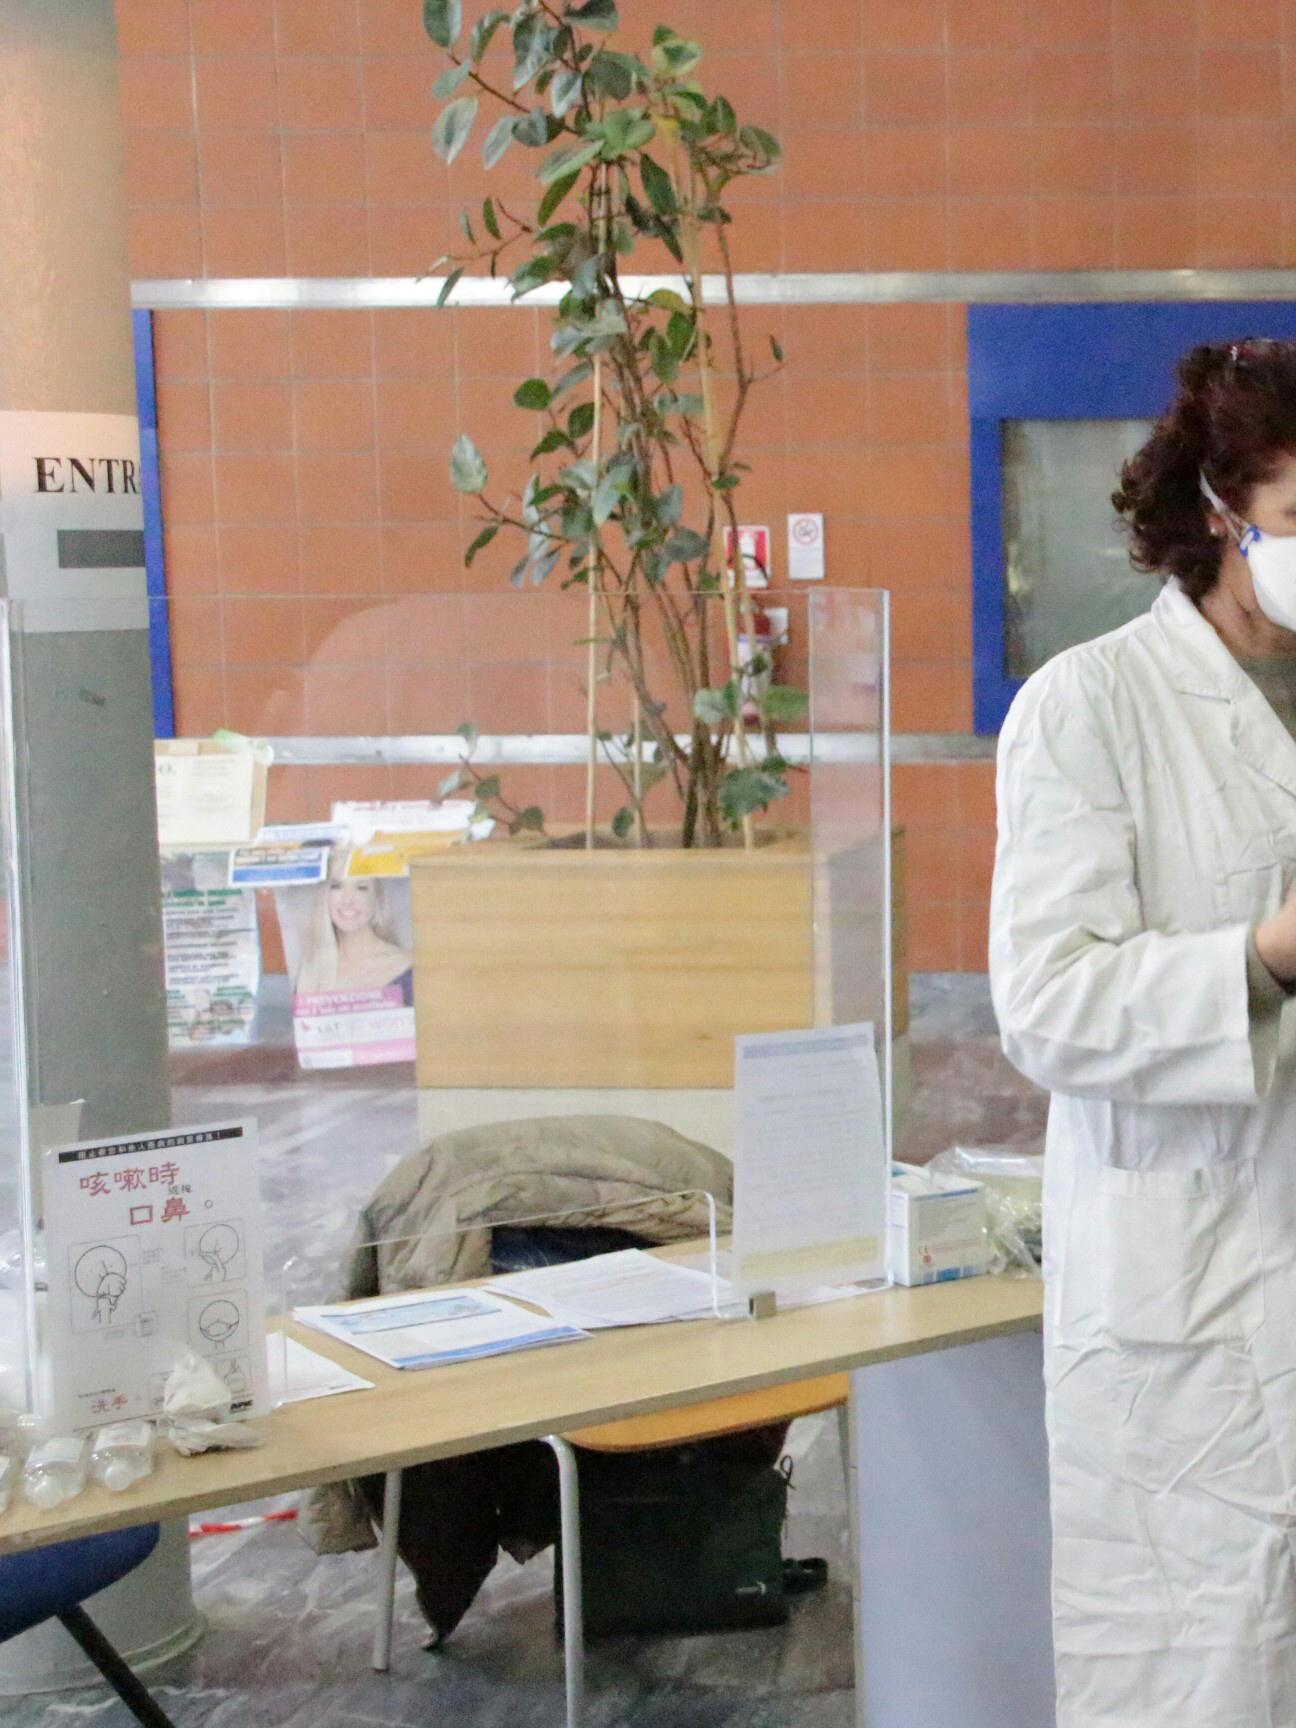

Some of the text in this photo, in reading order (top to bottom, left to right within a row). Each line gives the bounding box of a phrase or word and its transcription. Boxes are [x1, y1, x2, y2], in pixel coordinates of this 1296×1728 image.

[33, 456, 140, 495] ENTR
[79, 1161, 180, 1197] 咳嗽時
